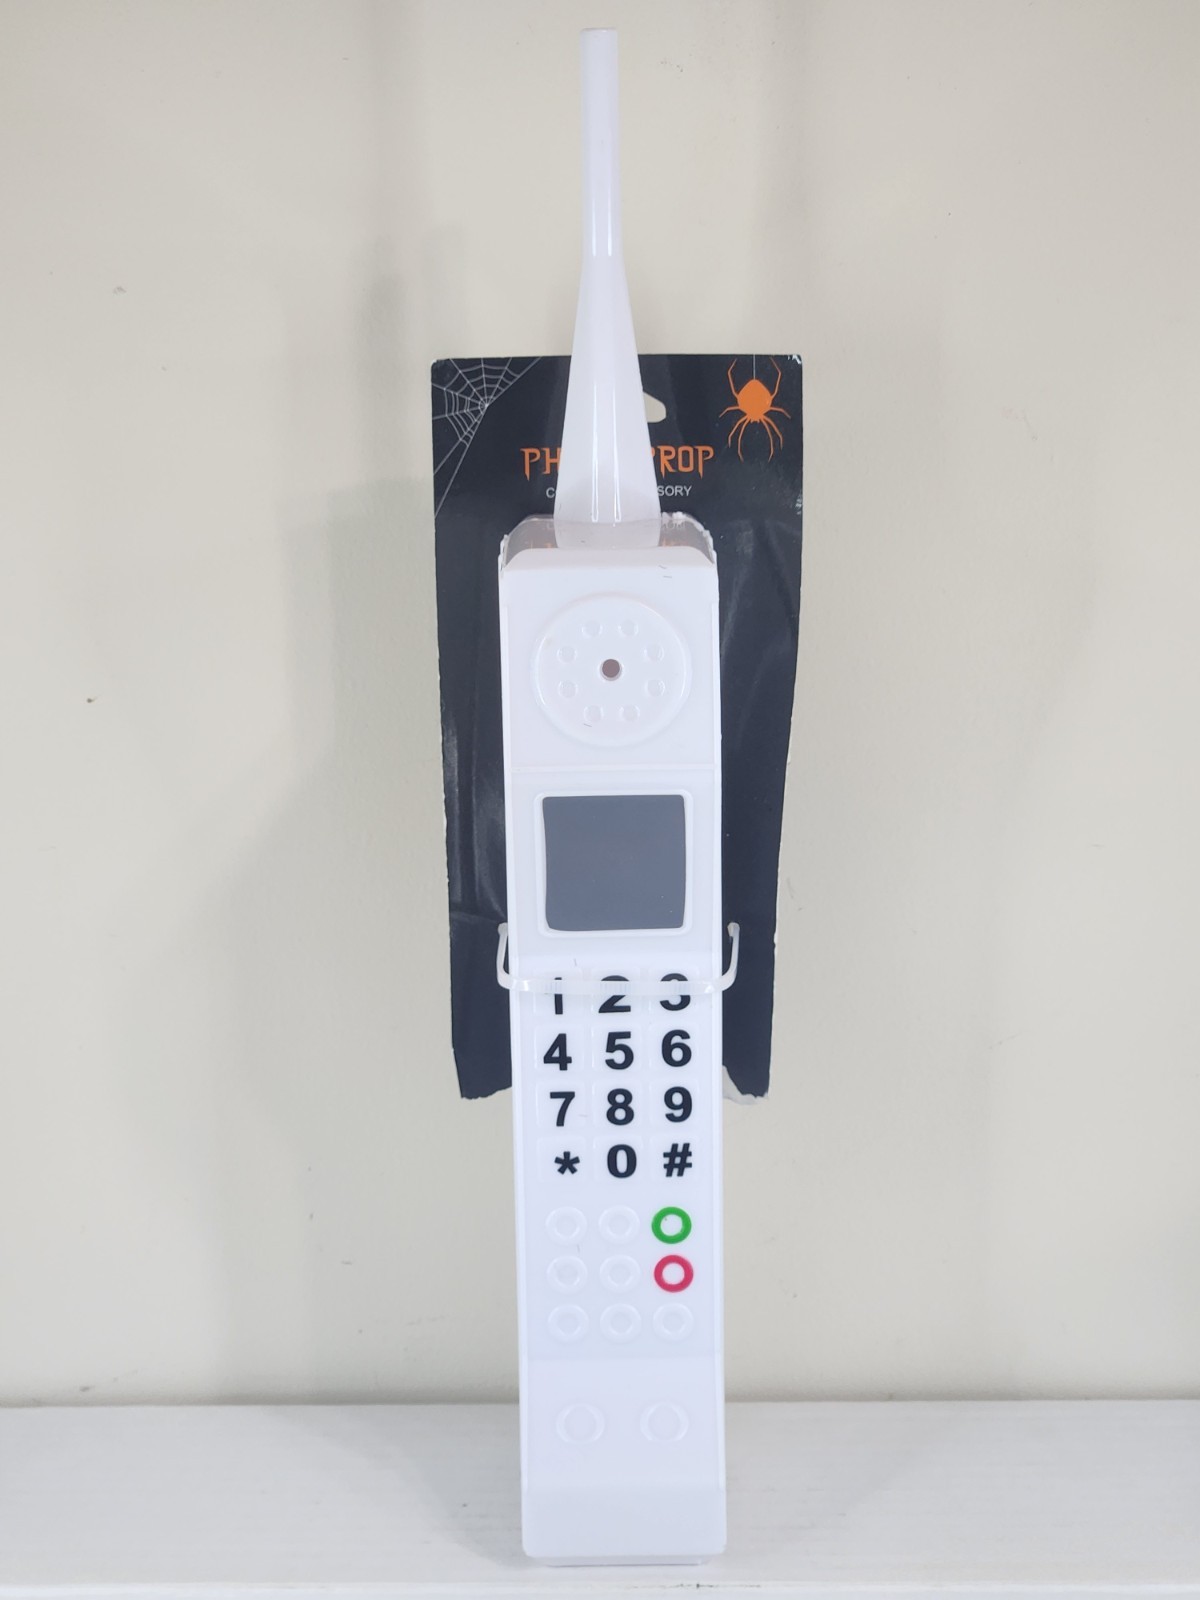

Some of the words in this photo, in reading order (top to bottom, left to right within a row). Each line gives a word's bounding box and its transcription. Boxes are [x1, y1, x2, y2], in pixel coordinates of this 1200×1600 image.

[650, 444, 715, 479] ROP
[598, 974, 632, 1015] 2
[659, 972, 692, 1012] 3
[543, 1033, 573, 1071] 4
[604, 1031, 634, 1070] 5
[661, 1029, 692, 1068] 6
[549, 1091, 576, 1127] 7
[606, 1088, 635, 1126] 8
[663, 1086, 693, 1123] 9
[606, 1144, 637, 1179] 0
[662, 1142, 693, 1178] #
